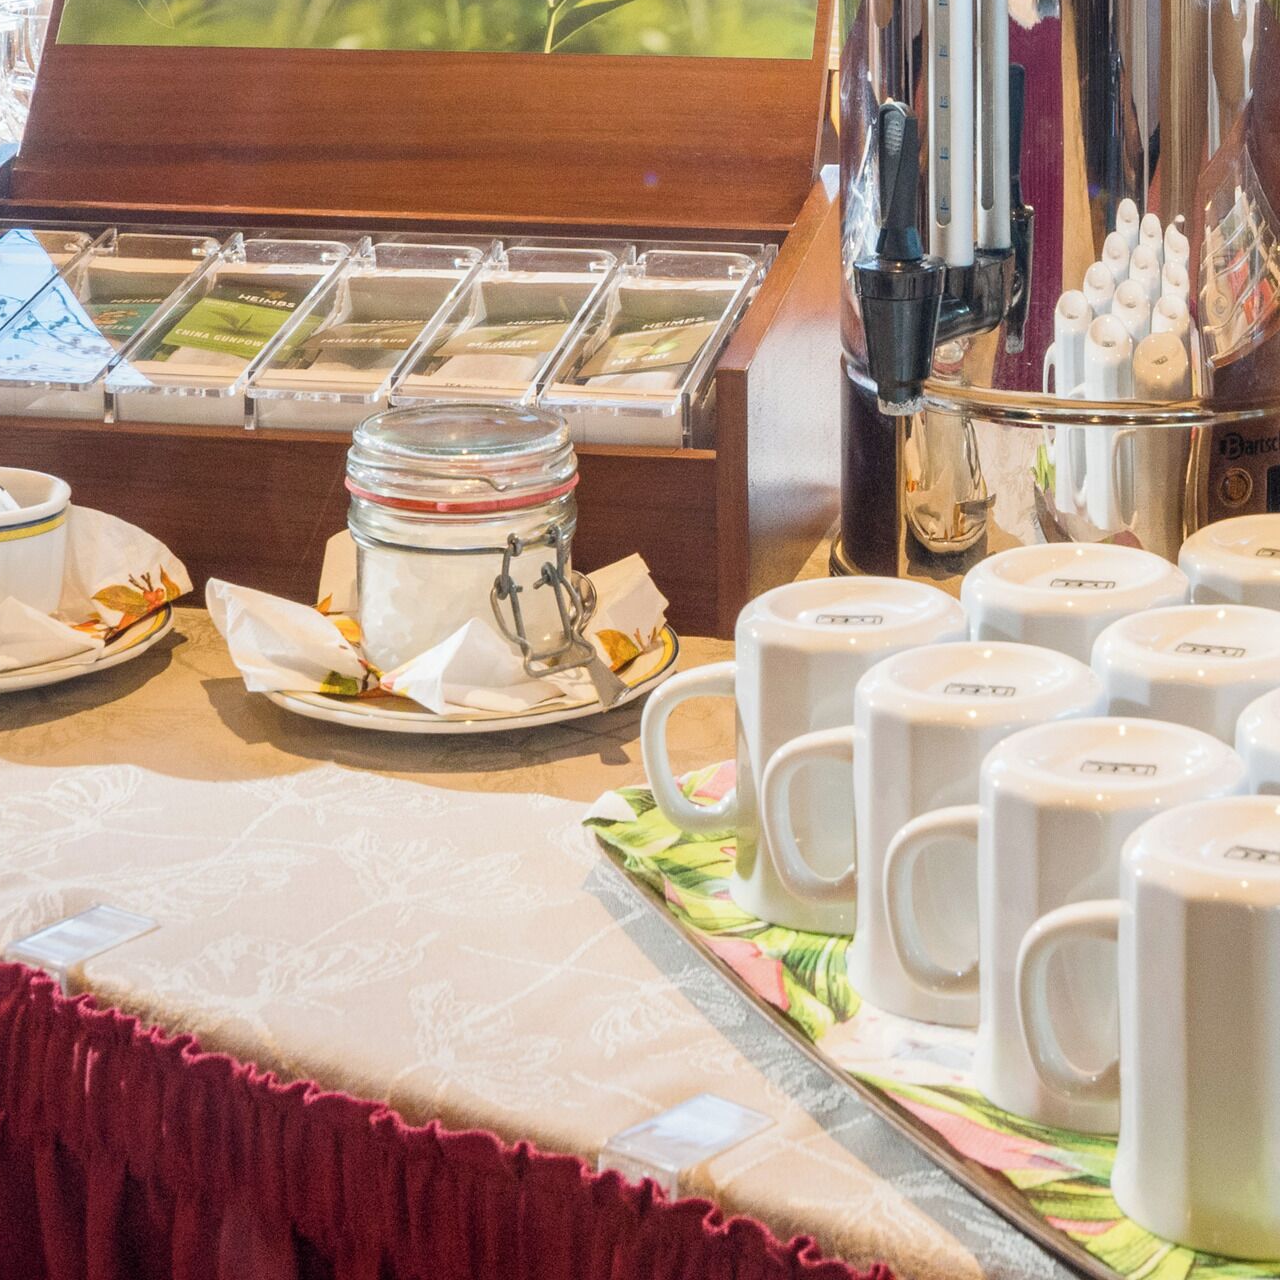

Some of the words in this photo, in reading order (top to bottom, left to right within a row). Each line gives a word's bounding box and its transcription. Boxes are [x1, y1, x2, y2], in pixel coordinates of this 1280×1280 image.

[238, 293, 297, 309] HEIMBS
[641, 316, 705, 330] HEIMBS
[175, 327, 210, 341] CHINA
